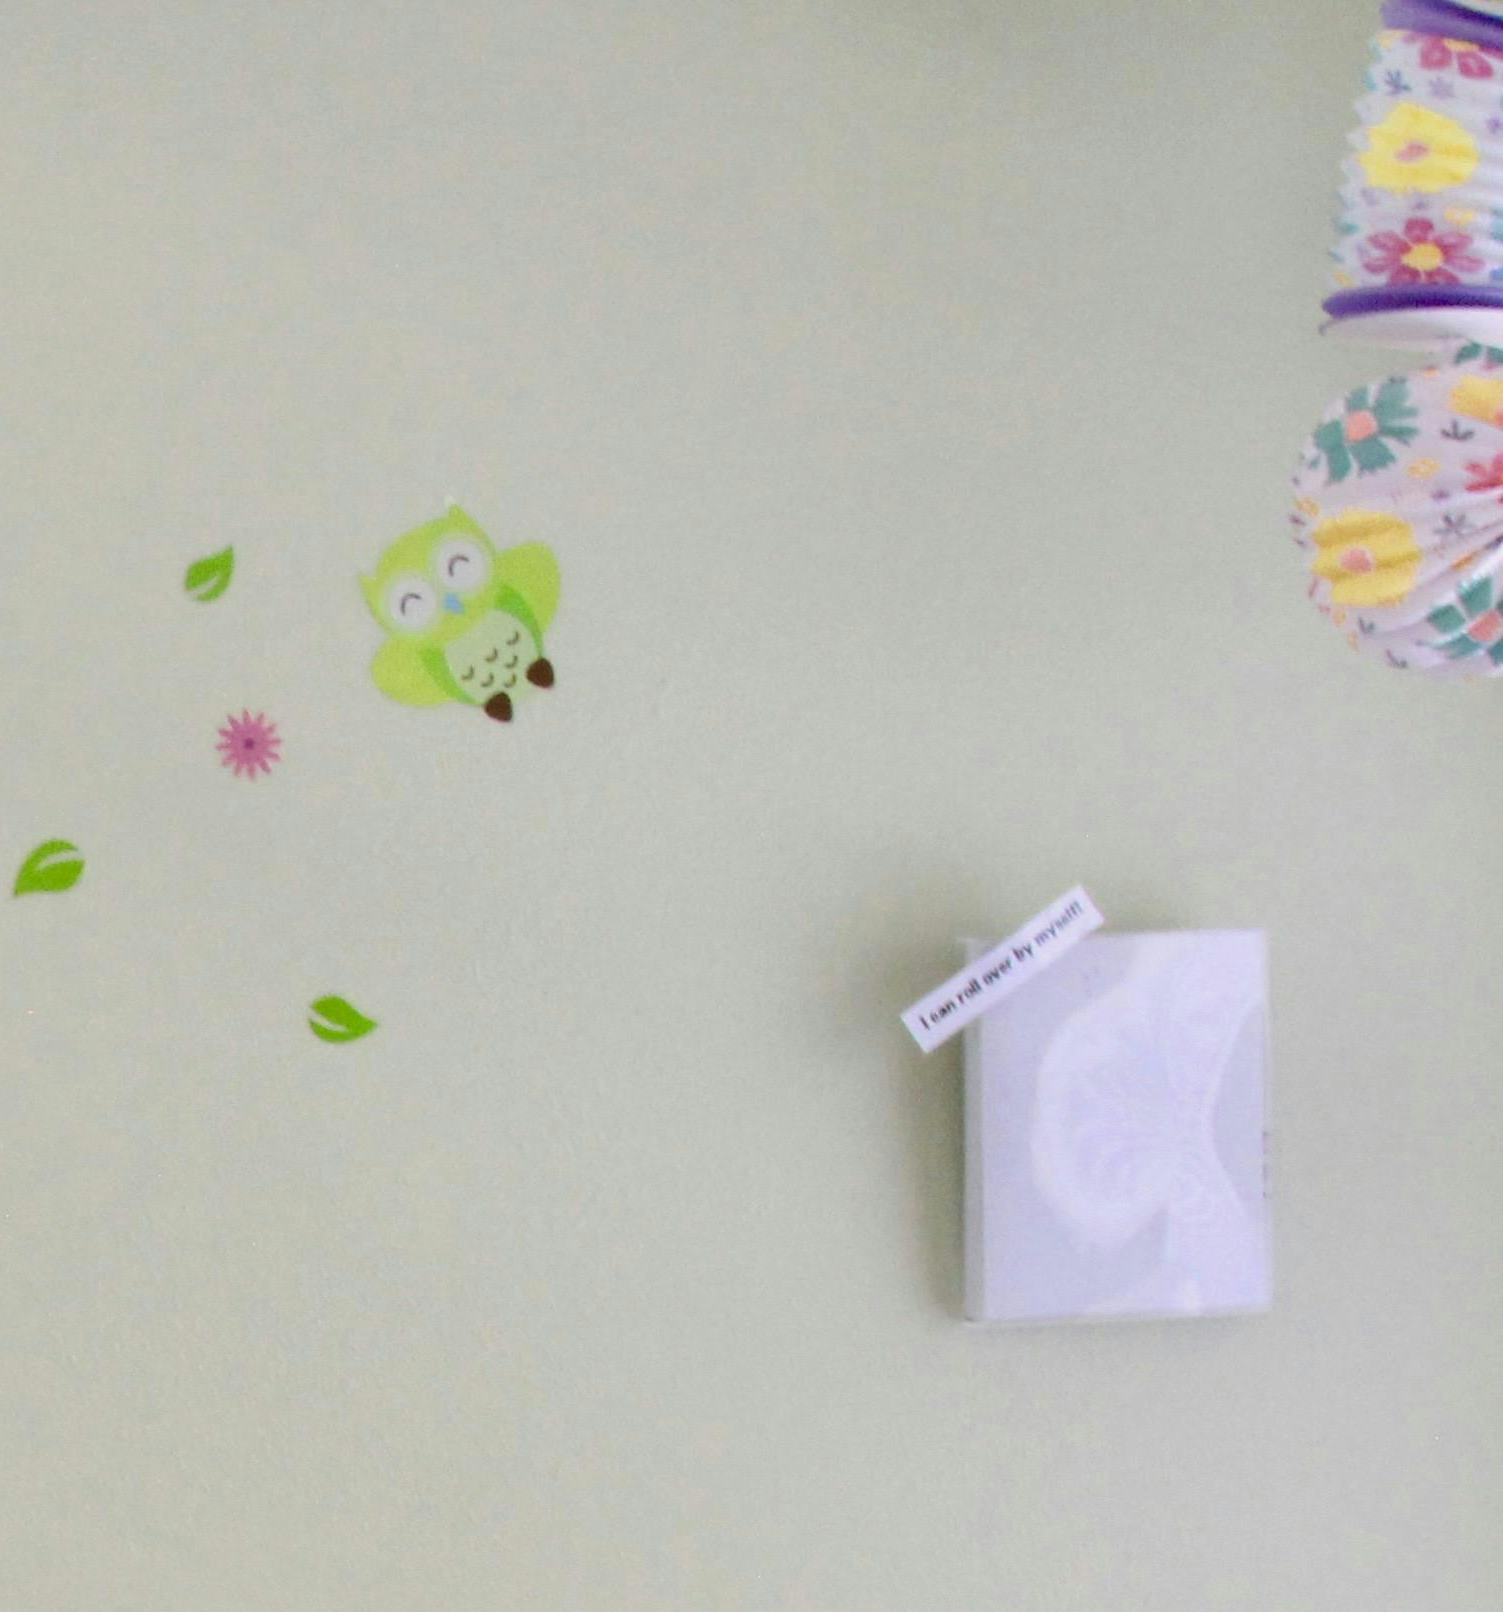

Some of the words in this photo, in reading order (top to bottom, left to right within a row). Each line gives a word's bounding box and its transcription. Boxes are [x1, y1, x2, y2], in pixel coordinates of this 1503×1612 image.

[919, 1013, 931, 1031] I
[929, 998, 957, 1024] can
[956, 977, 983, 1005] roll
[982, 956, 1013, 986] over
[1011, 942, 1034, 962] by
